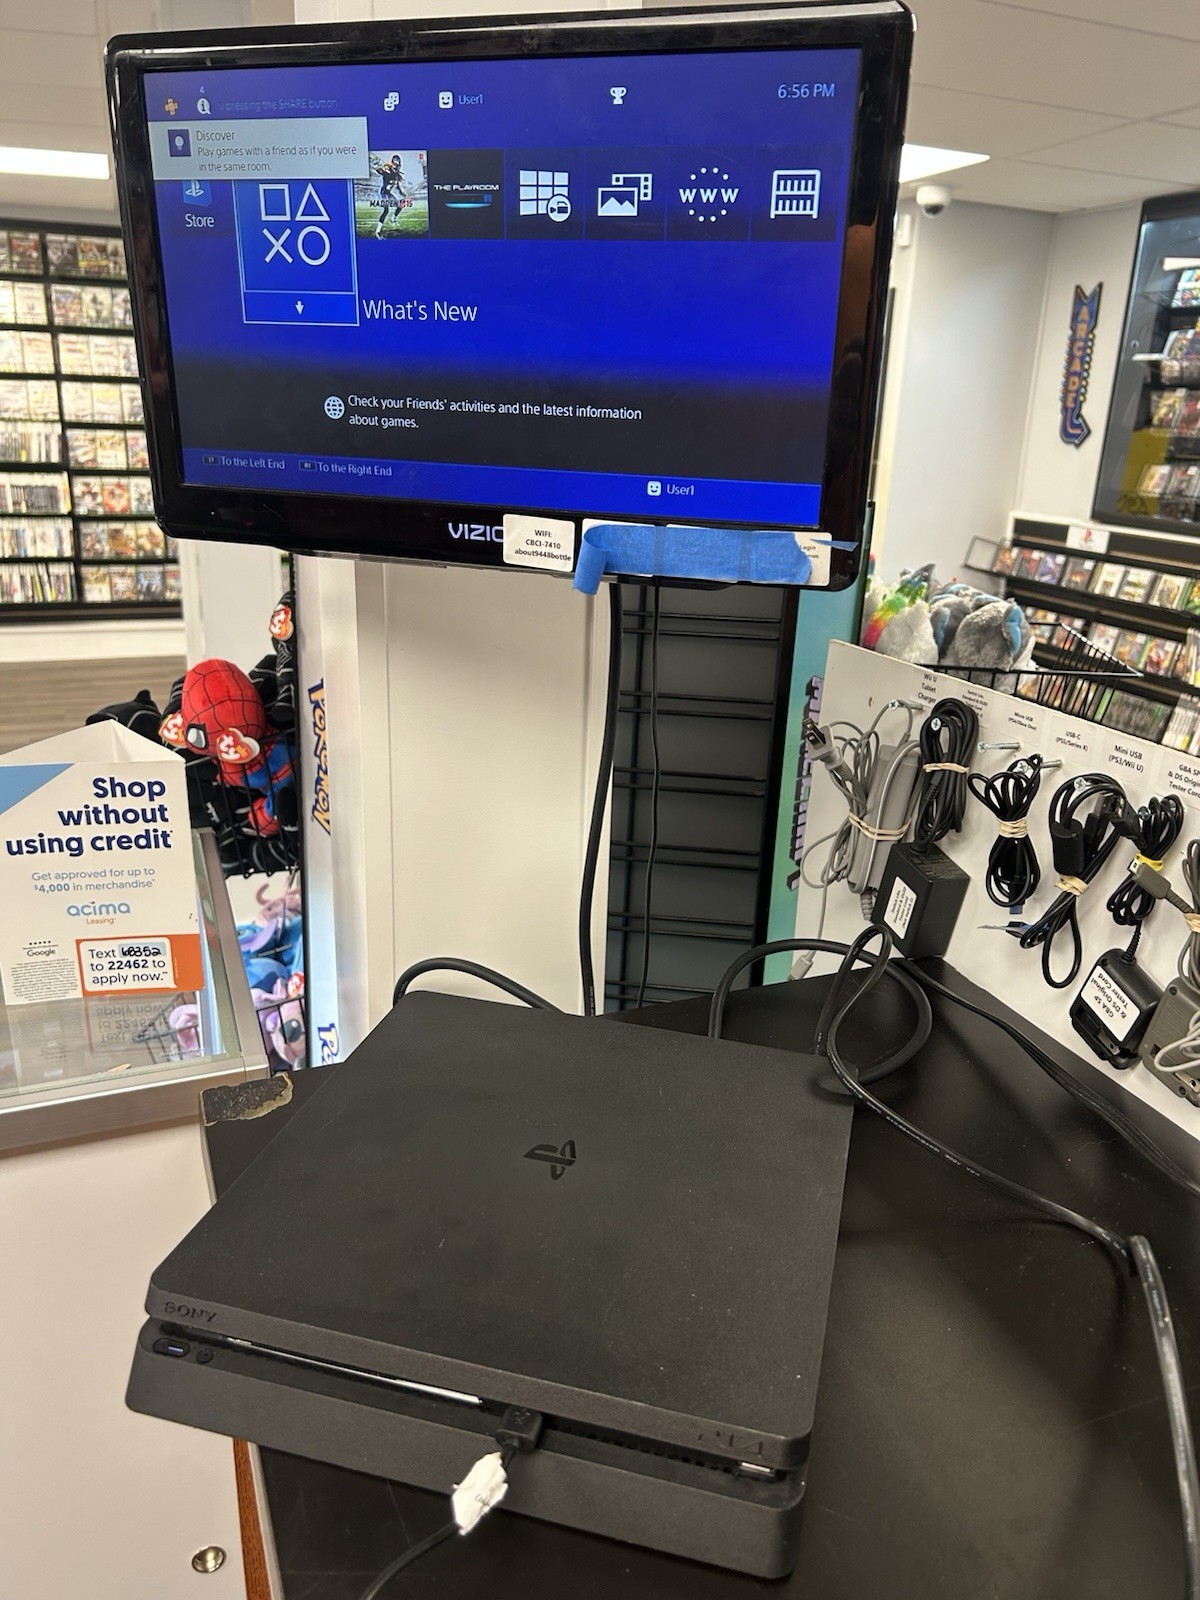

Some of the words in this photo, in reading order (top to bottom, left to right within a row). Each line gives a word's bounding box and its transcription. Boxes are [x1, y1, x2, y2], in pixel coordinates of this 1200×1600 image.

[777, 84, 810, 99] 6:56
[813, 83, 836, 98] PM
[458, 94, 483, 105] User1
[196, 130, 235, 141] Discover
[198, 147, 214, 158] Play
[215, 148, 244, 158] games
[245, 146, 264, 156] with
[272, 145, 297, 155] friend
[298, 147, 309, 155] as
[310, 145, 317, 155] if
[317, 147, 333, 158] you
[335, 146, 357, 155] were
[199, 162, 207, 172] in
[208, 161, 222, 172] the
[223, 163, 246, 172] same
[248, 162, 272, 172] room.
[185, 213, 215, 228] Store
[363, 299, 427, 321] What's
[434, 301, 478, 322] New
[1065, 304, 1091, 408] ARCADE
[348, 395, 378, 408] Check
[381, 398, 404, 411] your
[406, 397, 447, 411] Friends'
[450, 399, 496, 414] activities
[498, 402, 520, 415] and
[522, 403, 541, 416] the
[543, 404, 573, 417] latest
[576, 405, 642, 420] information
[349, 414, 379, 427] about
[381, 417, 419, 430] games.
[221, 456, 232, 466] To
[233, 456, 248, 467] the
[250, 458, 266, 468] Left
[268, 459, 285, 470] End
[317, 462, 330, 472] To
[331, 463, 347, 473] the
[348, 464, 372, 476] Right
[374, 466, 392, 476] End
[666, 484, 695, 496] User1
[534, 529, 552, 539] WIFI:
[525, 539, 561, 550] CBCI-7410
[514, 548, 572, 562] about9448bottle
[921, 683, 937, 693] Tablet
[1065, 730, 1081, 740] USB-C
[1114, 745, 1129, 756] Mini
[1129, 750, 1143, 760] USB
[1108, 754, 1135, 770] (PS3/Wii
[1136, 763, 1144, 773] U)
[1178, 764, 1192, 774] GBA
[1174, 773, 1183, 781] DS
[93, 777, 166, 802] Shop
[1169, 781, 1187, 792] Tester
[58, 804, 169, 826] without
[6, 832, 85, 857] using
[32, 872, 51, 881] Get
[55, 869, 107, 881] approved
[109, 868, 124, 877] for
[127, 869, 142, 879] up
[144, 868, 155, 876] to
[34, 884, 70, 894] $4,000
[73, 883, 82, 891] in
[67, 901, 131, 916] acima
[26, 947, 57, 957] Google
[88, 948, 116, 959] Text
[91, 962, 104, 972] to
[108, 959, 149, 970] 22462
[152, 959, 165, 968] to
[92, 973, 128, 985] apply
[1098, 973, 1112, 989] Cord
[1091, 977, 1112, 1003] Original
[1094, 995, 1102, 1004] SP
[1112, 989, 1129, 1009] Tester
[1102, 1002, 1114, 1018] GBA
[1112, 1002, 1121, 1012] DS
[164, 1301, 217, 1322] SONY
